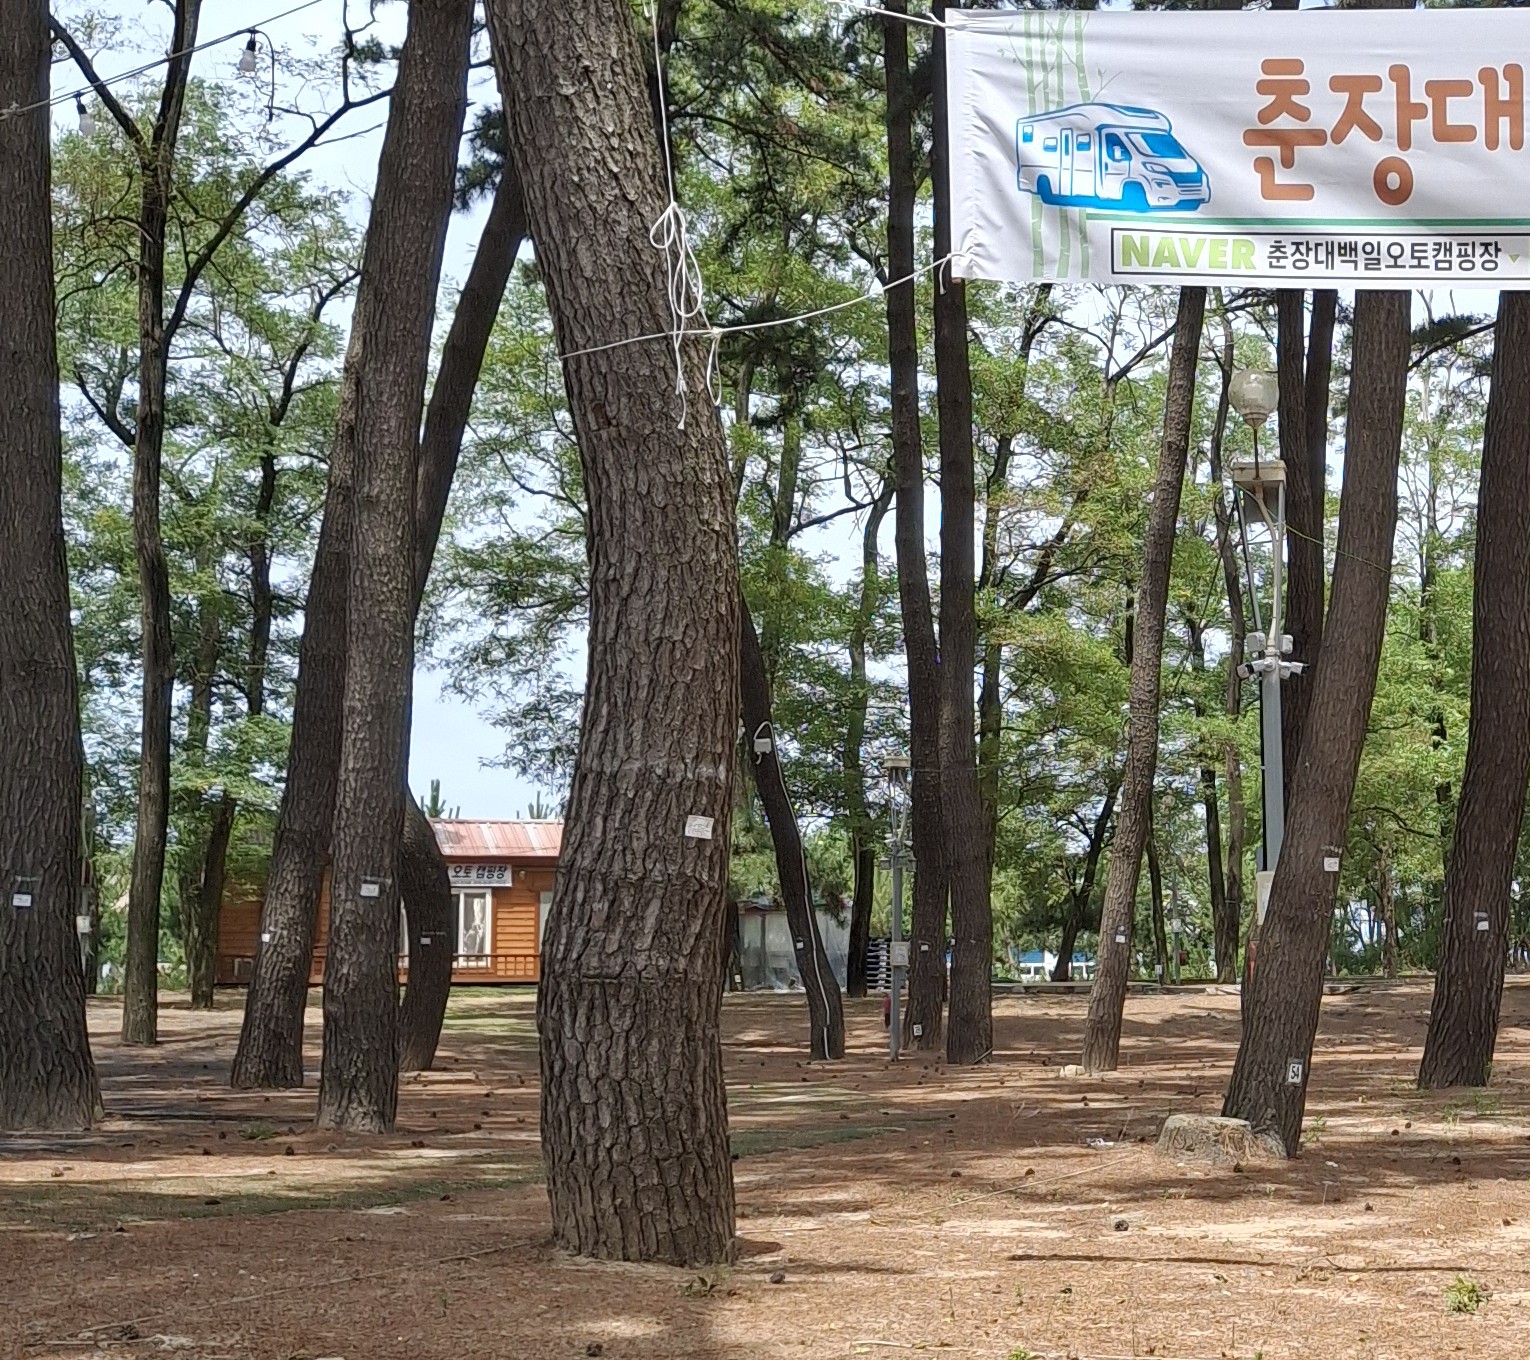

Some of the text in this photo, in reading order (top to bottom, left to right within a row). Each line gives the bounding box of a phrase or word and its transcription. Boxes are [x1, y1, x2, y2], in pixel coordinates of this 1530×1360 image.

[1243, 58, 1524, 206] 춘장대
[1121, 234, 1257, 270] NAVER
[1267, 240, 1502, 272] 춘장대백일오토캠핑장
[451, 865, 473, 878] 오토
[1290, 1065, 1300, 1080] 54
